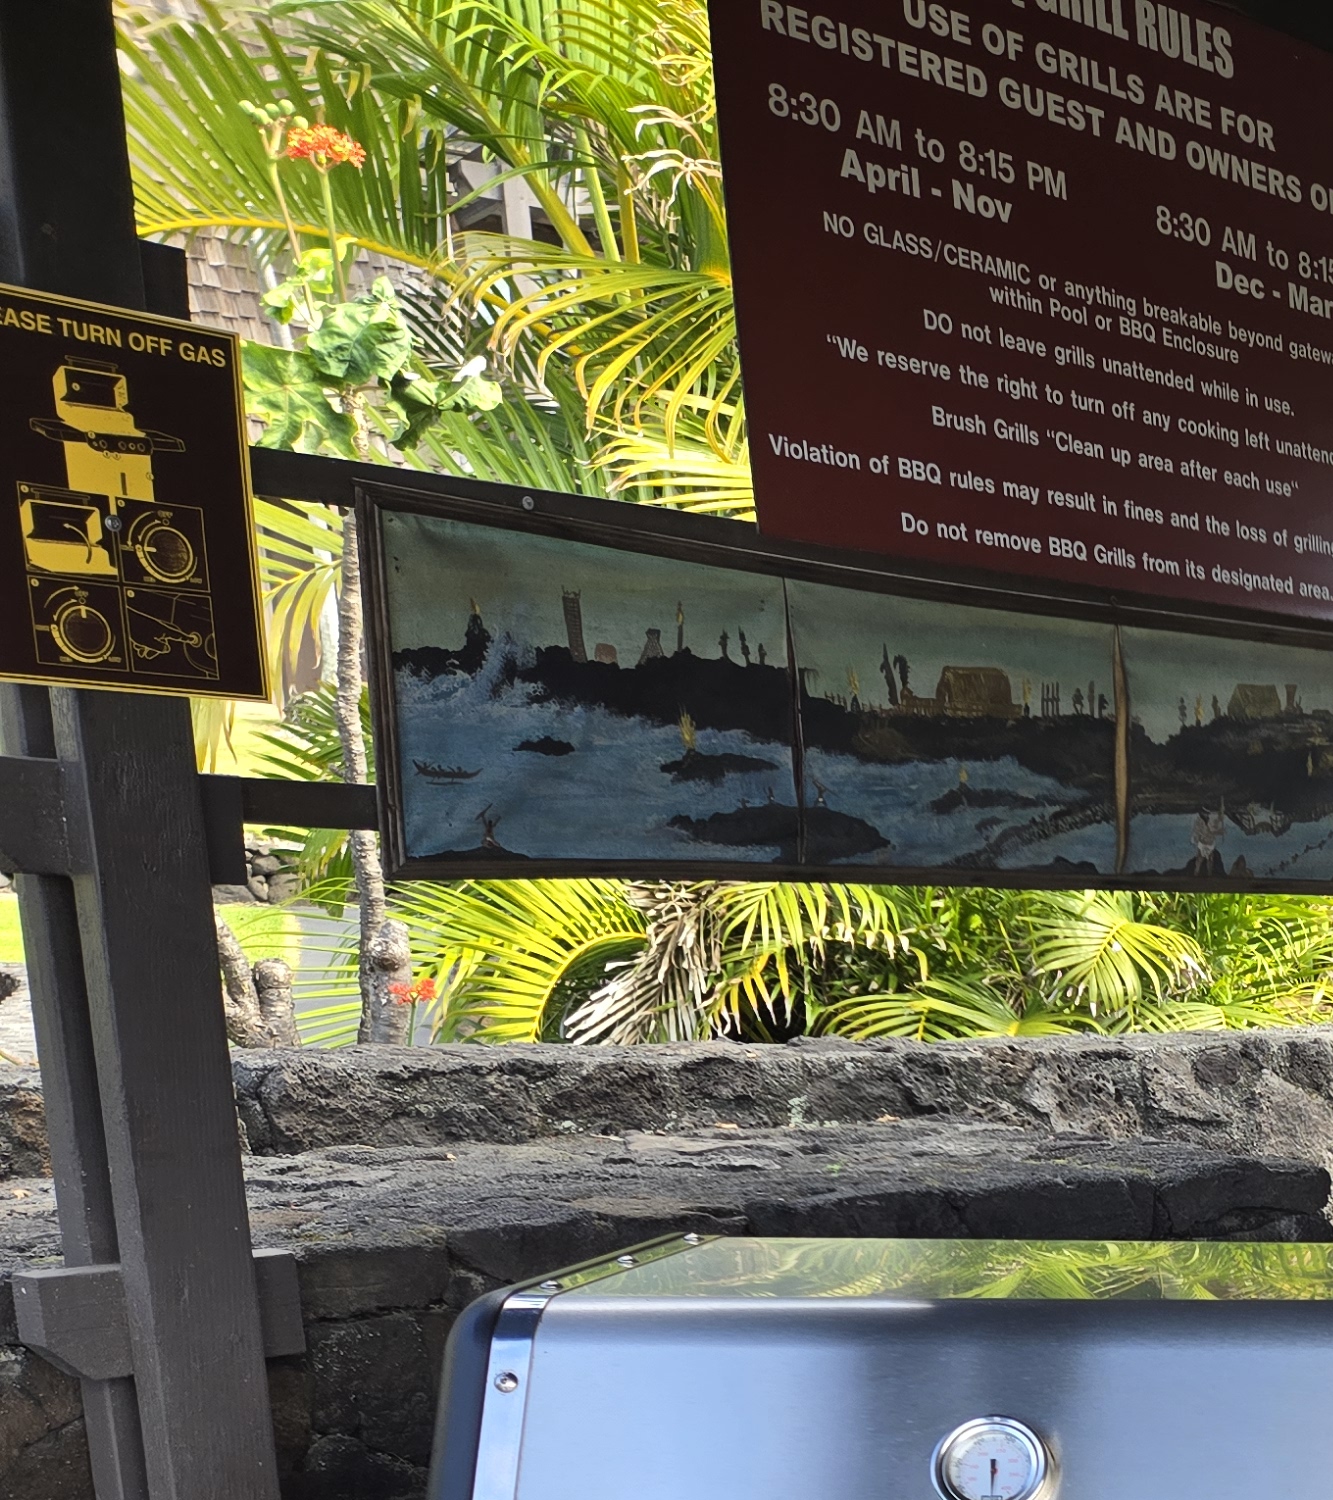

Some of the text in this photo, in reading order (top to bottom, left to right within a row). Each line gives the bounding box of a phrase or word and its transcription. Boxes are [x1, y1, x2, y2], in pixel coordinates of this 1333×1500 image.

[903, 0, 1276, 152] USE OF GRILLS ARE FOR
[1135, 0, 1234, 79] RULES
[760, 0, 988, 98] REGISTERED
[998, 77, 1105, 137] GUEST
[1115, 116, 1176, 160] AND
[1186, 140, 1302, 203] OWNERS
[768, 83, 1067, 201] 8:30 AM to 8:15 PM
[840, 148, 1013, 223] April - Nov
[823, 211, 855, 238] NO
[863, 222, 1031, 285] GLASS/CERAMIC
[1038, 274, 1057, 292] or
[1064, 280, 1137, 316] anything
[1143, 296, 1222, 336] breakable
[1228, 320, 1283, 352] beyond
[1156, 205, 1211, 247] 8:30
[1221, 226, 1257, 262] AM
[1266, 240, 1289, 271] to
[989, 285, 1239, 364] within Pool or BBQ Enclosure
[1215, 260, 1333, 319] Dec - Mar
[57, 318, 122, 348] TURN
[128, 332, 173, 357] OFF
[178, 342, 227, 368] GAS
[923, 308, 1295, 417] DO not leave grills unattended while in use.
[877, 350, 951, 381] reserve
[958, 364, 990, 389] the
[996, 373, 1039, 401] right
[1044, 383, 1064, 406] to
[1070, 389, 1105, 415] turn
[1111, 400, 1135, 422] off
[1142, 409, 1171, 433] any
[1178, 417, 1239, 448] cooking
[1244, 427, 1271, 452] left
[768, 433, 861, 471] Violation
[869, 454, 890, 476] of
[897, 456, 942, 485] BBQ
[949, 470, 996, 494] rules
[1002, 481, 1040, 506] may
[1047, 489, 1097, 513] result
[1102, 494, 1118, 517] in
[1123, 499, 1164, 525] fines
[1170, 511, 1200, 532] and
[1205, 514, 1231, 537] the
[1235, 519, 1268, 545] loss
[1272, 528, 1288, 548] of
[931, 405, 987, 436] Brush
[993, 418, 1040, 446] Grills
[1110, 446, 1131, 468] up
[1138, 452, 1174, 474] area
[1180, 459, 1218, 483] after
[1223, 470, 1261, 492] each
[900, 511, 1333, 602] Do not remove BBQ Grills from its designated area.
